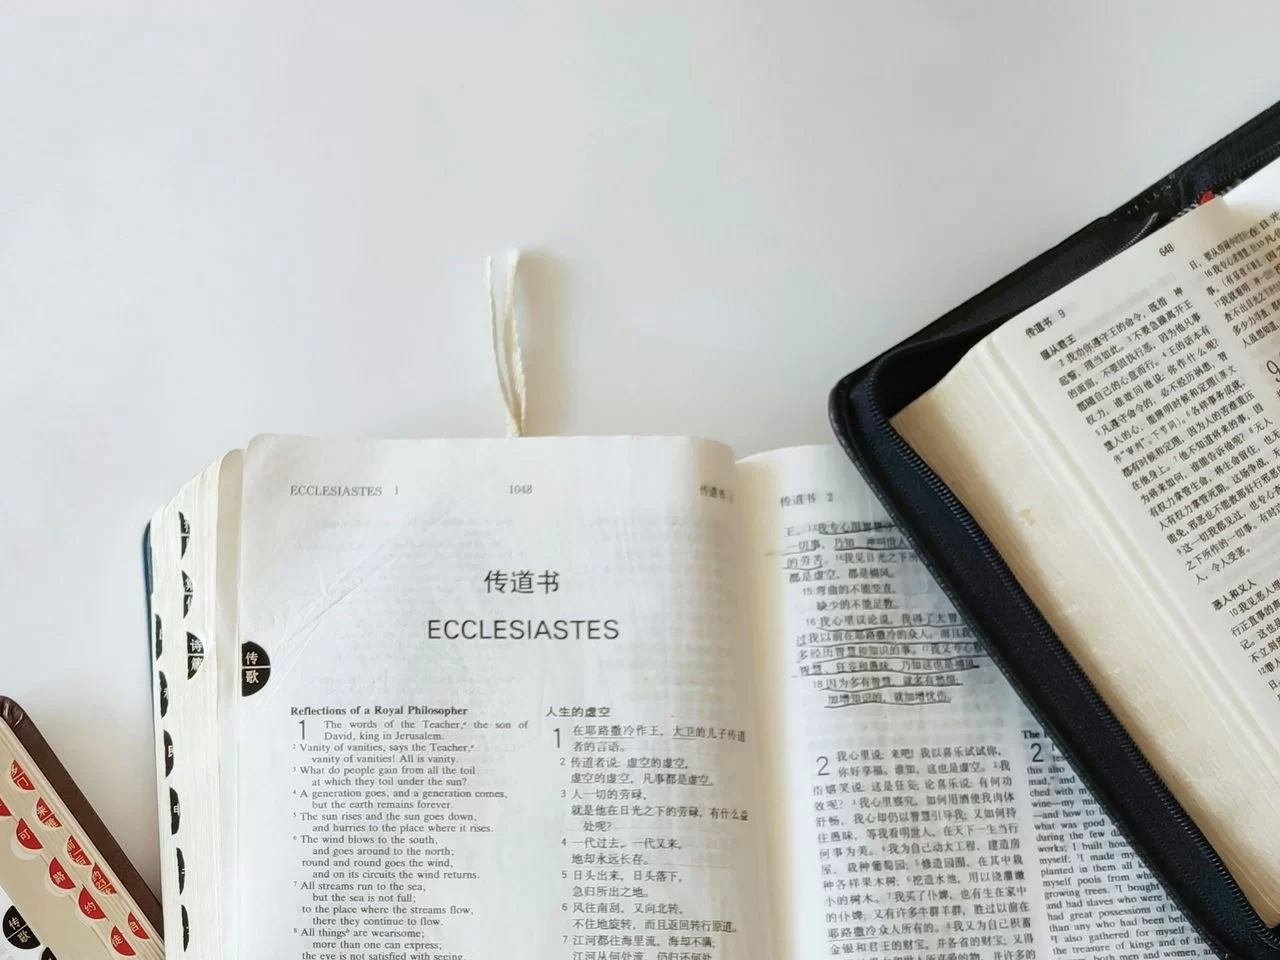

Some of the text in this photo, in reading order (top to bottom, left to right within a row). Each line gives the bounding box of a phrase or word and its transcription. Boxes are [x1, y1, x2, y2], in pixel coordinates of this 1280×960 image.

[1025, 317, 1052, 338] 传道书
[290, 485, 382, 496] ECCLESIASTES
[509, 484, 533, 494] 1048
[484, 570, 560, 595] 传道书
[428, 619, 619, 640] ECCLESIASTES
[245, 652, 259, 665] 传
[246, 671, 259, 683] 歌
[291, 706, 346, 716] Reflections
[350, 706, 360, 715] of
[375, 706, 403, 717] Royal
[408, 705, 468, 717] Philosopher
[546, 707, 610, 717] 人生的虚空
[298, 720, 305, 740] 1
[324, 721, 341, 729] The
[350, 721, 377, 729] words
[384, 720, 394, 729] of
[401, 721, 415, 729] the
[473, 721, 488, 729] the
[518, 720, 528, 729] of
[324, 731, 444, 742] David, king in Jerusalem.
[554, 728, 561, 748] 1
[574, 741, 625, 752] 者的言语。
[1031, 743, 1044, 762] 2
[312, 755, 458, 765] vanity of vanities! All is vanity.
[816, 756, 830, 776] 2
[572, 854, 648, 865] 地却永远长存。
[9, 916, 21, 930] 传
[18, 930, 31, 943] 歌
